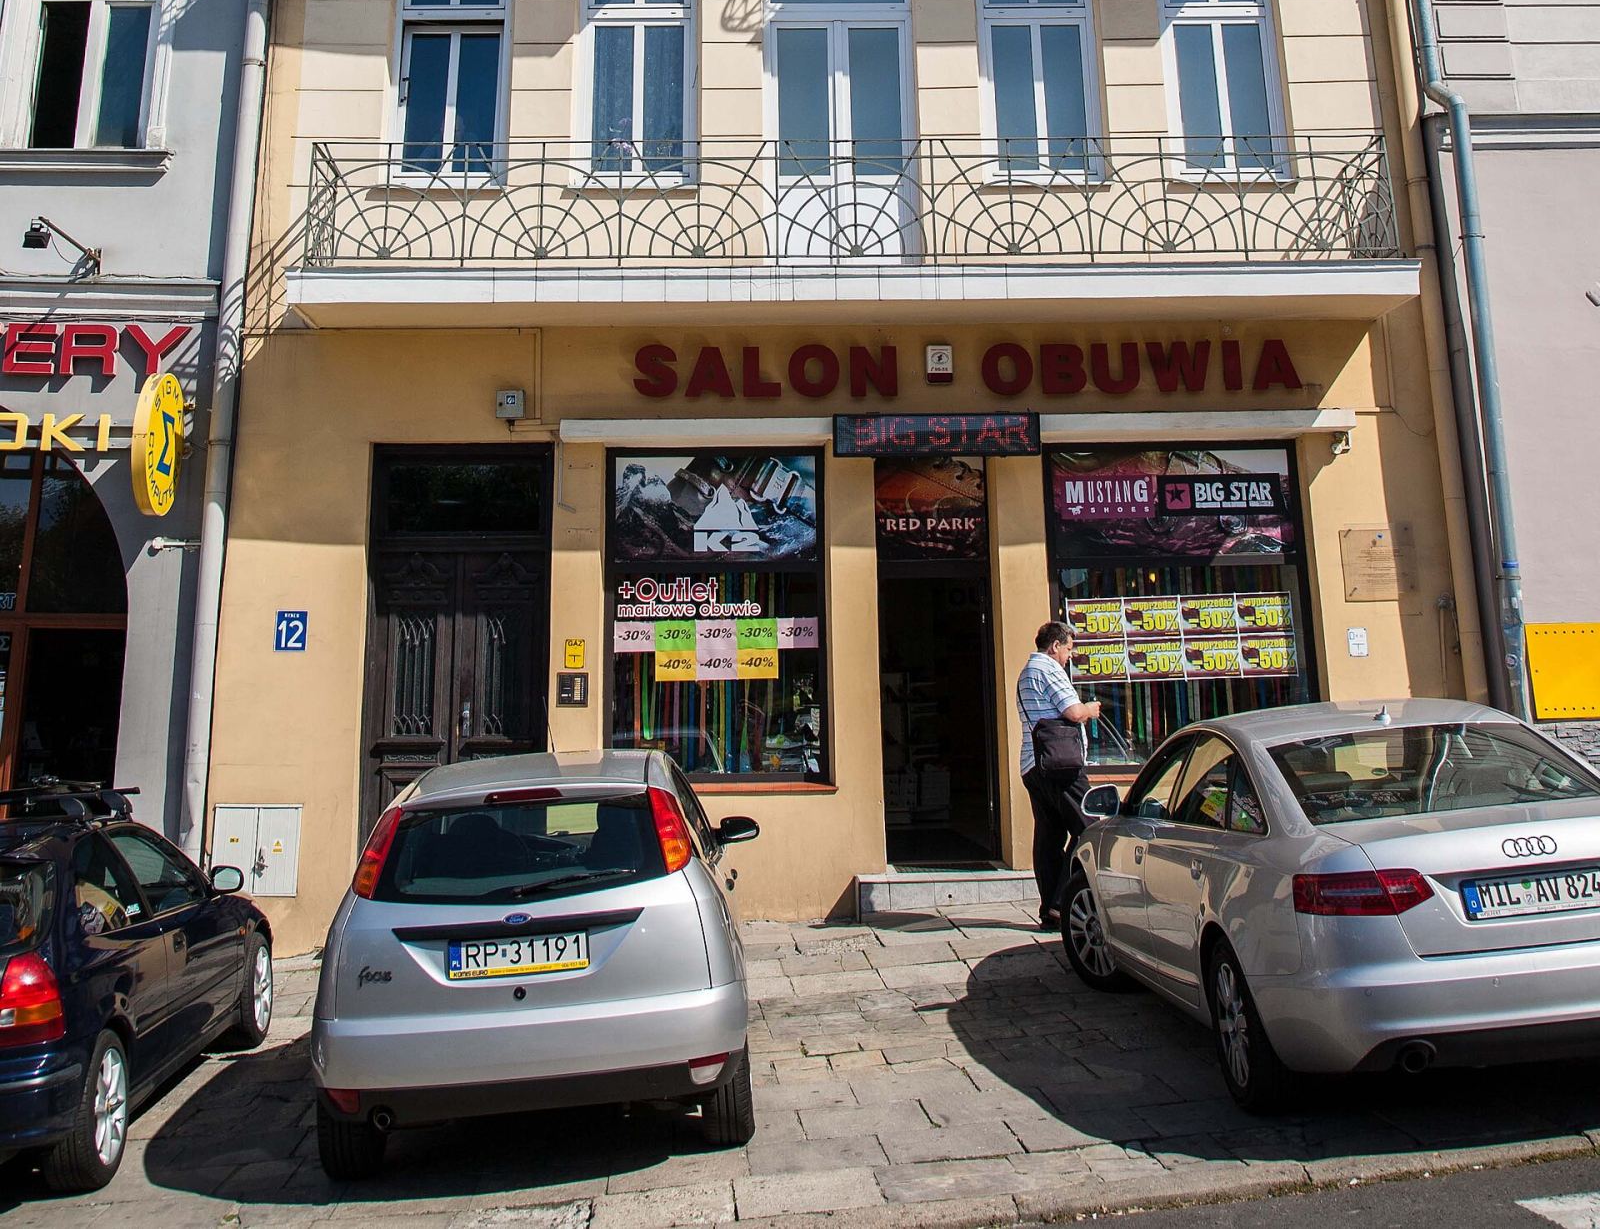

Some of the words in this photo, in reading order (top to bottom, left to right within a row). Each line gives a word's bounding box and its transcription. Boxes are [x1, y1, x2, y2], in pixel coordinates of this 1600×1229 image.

[0, 323, 193, 376] ERY
[633, 345, 899, 398] SALON
[981, 338, 1303, 394] OBUWIA
[855, 418, 917, 446] BIG
[928, 416, 1030, 446] STAR
[148, 432, 177, 506] COMPUTE
[1065, 480, 1149, 503] MUSTANG
[1194, 482, 1225, 502] BIG
[1230, 482, 1272, 501] STAR
[1090, 506, 1150, 514] SHOES
[693, 531, 760, 552] K2
[618, 577, 719, 602] +Outlet
[617, 601, 697, 618] markowe
[699, 599, 761, 617] obuwie
[1244, 607, 1290, 627] -50%
[1075, 613, 1123, 633] -50%
[1131, 612, 1179, 631] -50%
[1188, 609, 1235, 629] -50%
[278, 620, 303, 648] 12
[618, 630, 651, 641] -30%
[659, 629, 692, 640] -30%
[699, 628, 732, 639] -30%
[740, 627, 773, 638] -30%
[781, 626, 814, 637] -30%
[659, 659, 692, 670] -40%
[699, 658, 733, 669] -40%
[741, 657, 774, 668] -40%
[1078, 655, 1126, 675] -50%
[1135, 653, 1183, 673] -50%
[1192, 651, 1239, 671] -50%
[1248, 649, 1295, 669] -50%
[1478, 881, 1521, 908] MIL
[1535, 877, 1560, 902] AV
[1565, 873, 1600, 899] 824
[465, 942, 499, 968] RP
[510, 935, 580, 964] 31191
